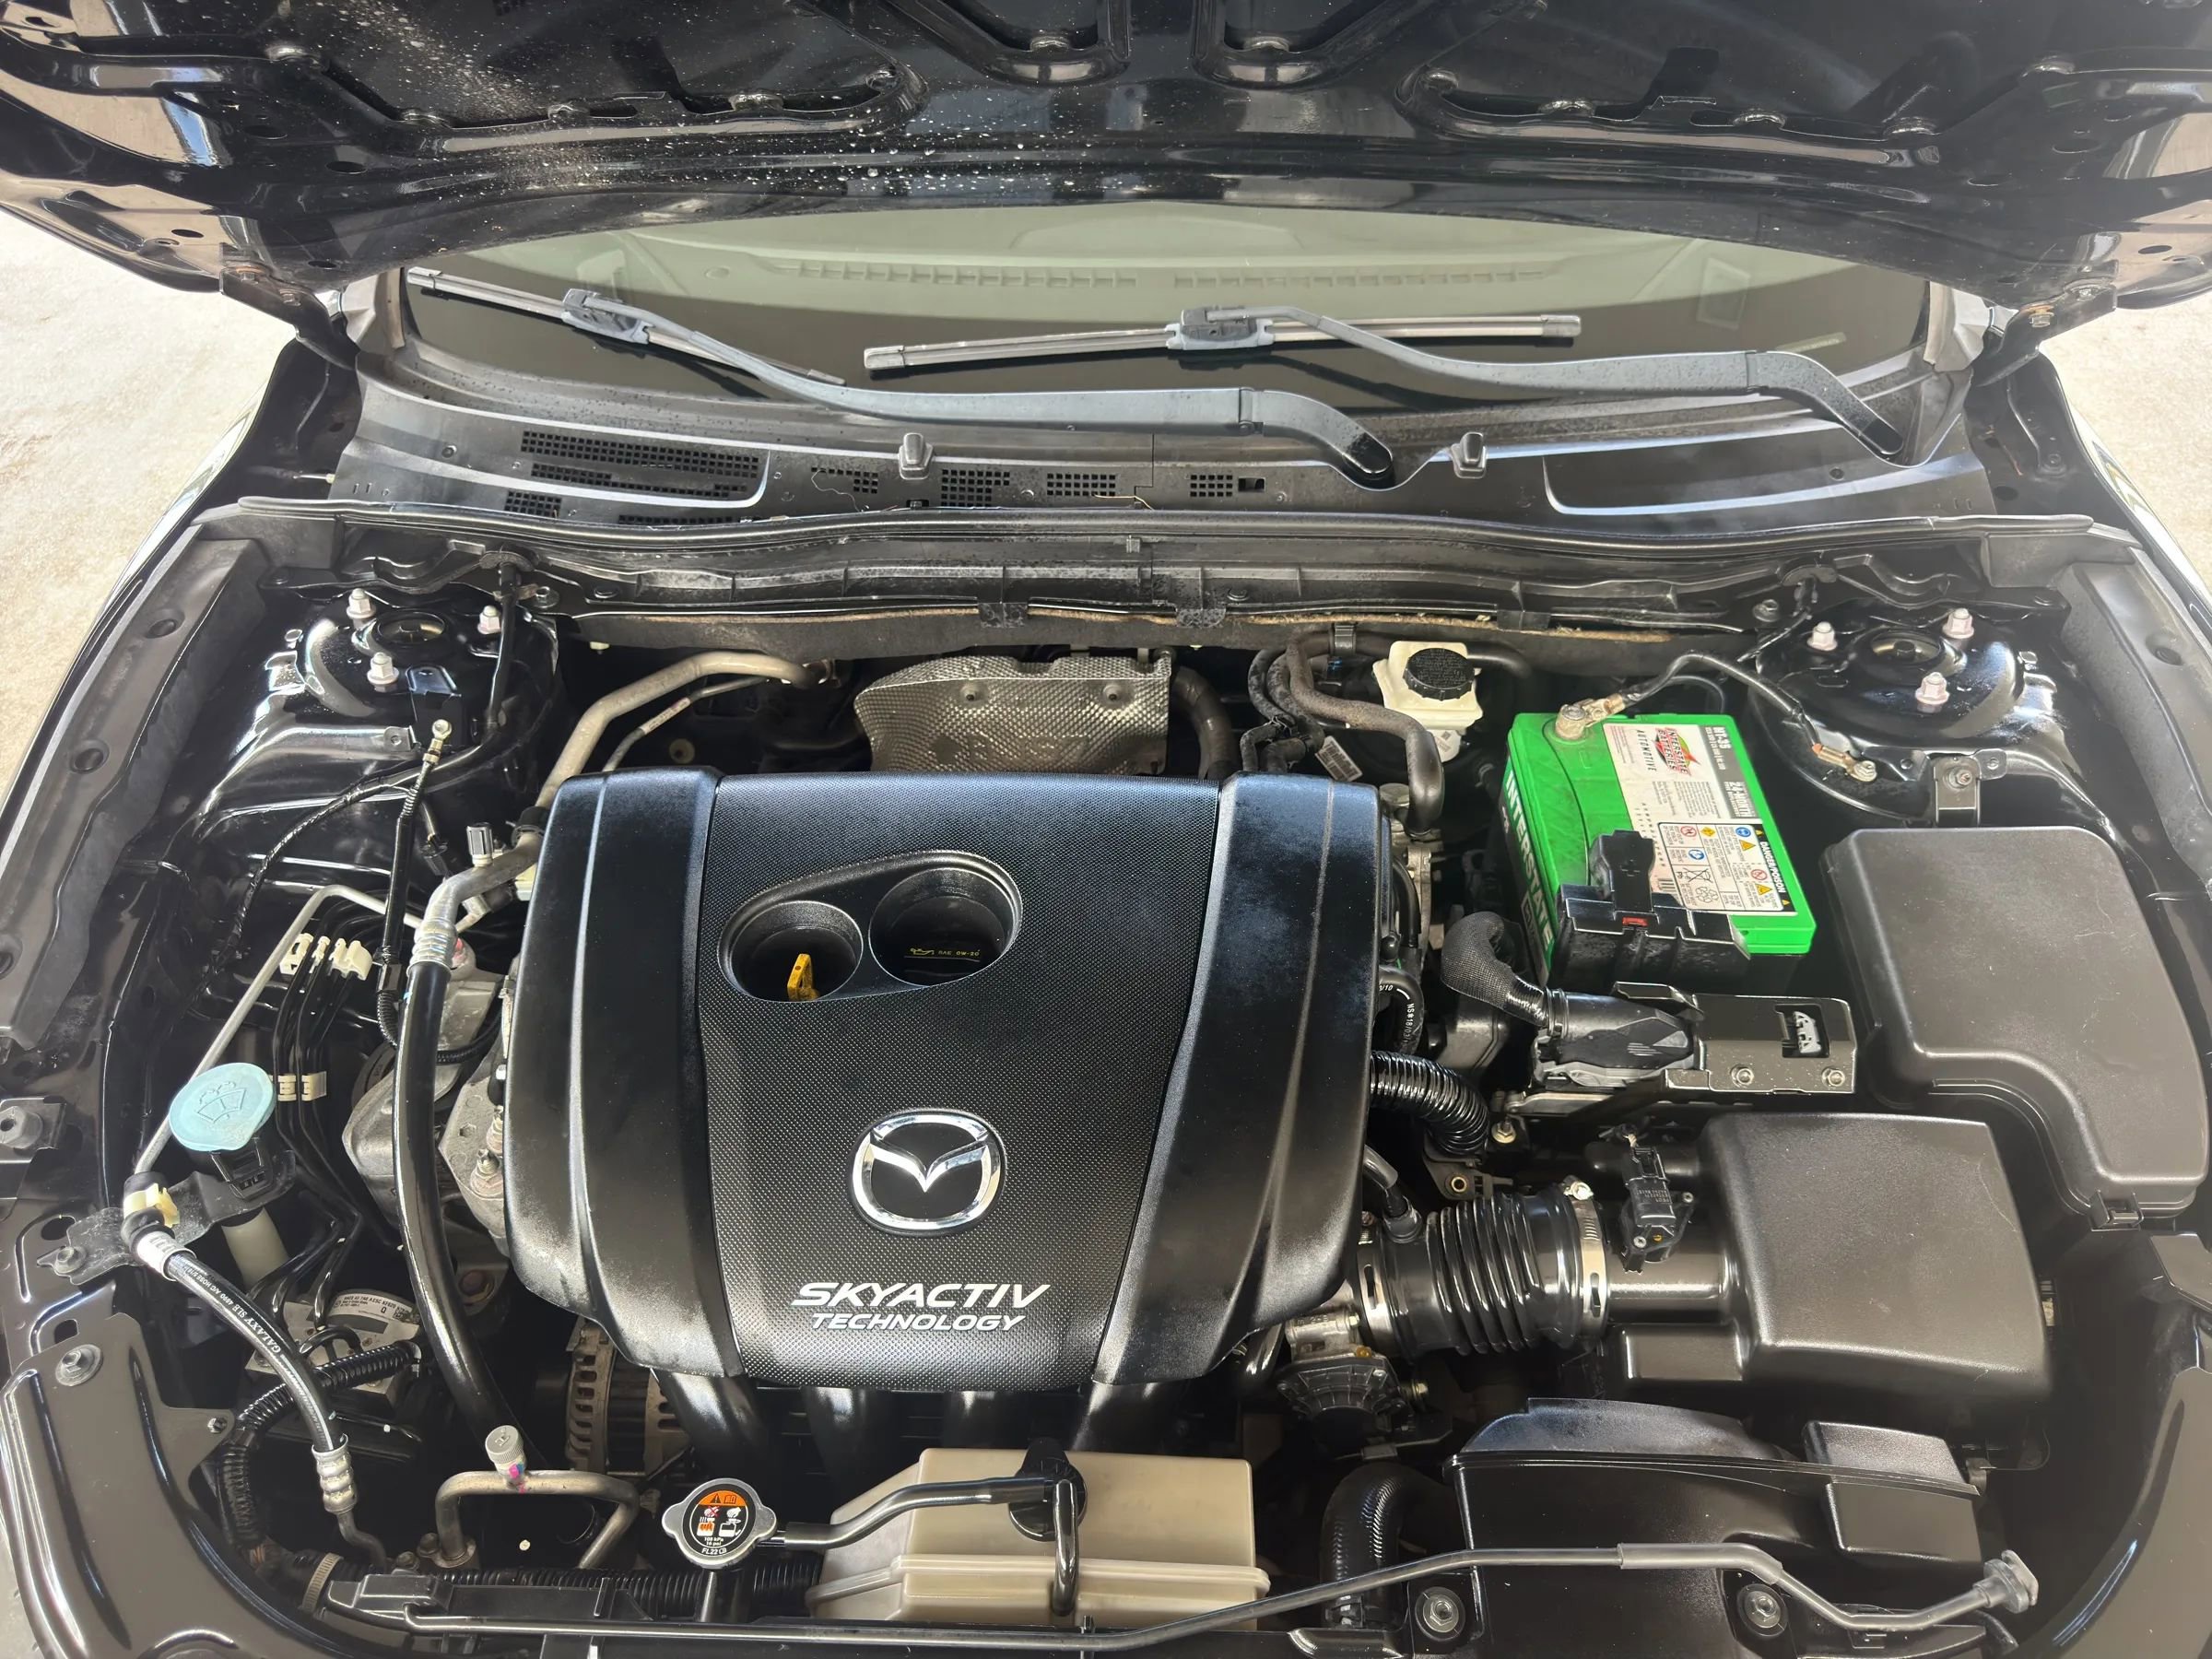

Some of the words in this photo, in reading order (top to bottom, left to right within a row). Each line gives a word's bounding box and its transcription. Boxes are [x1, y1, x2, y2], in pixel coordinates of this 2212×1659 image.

[1636, 729, 1657, 771] AUTOMOTIVE
[1659, 730, 1677, 770] BATTERIES
[1666, 729, 1688, 773] INTERSTATE
[1504, 772, 1554, 950] INTERSTATE
[1759, 841, 1786, 893] DANGER/POISON
[197, 1274, 211, 1288] HOSE
[210, 1285, 221, 1295] A/C
[791, 1282, 1051, 1308] SKYACTIV
[232, 1304, 247, 1318] SLE
[812, 1312, 1026, 1332] TECHNOLOGY
[244, 1317, 281, 1353] GALAXY
